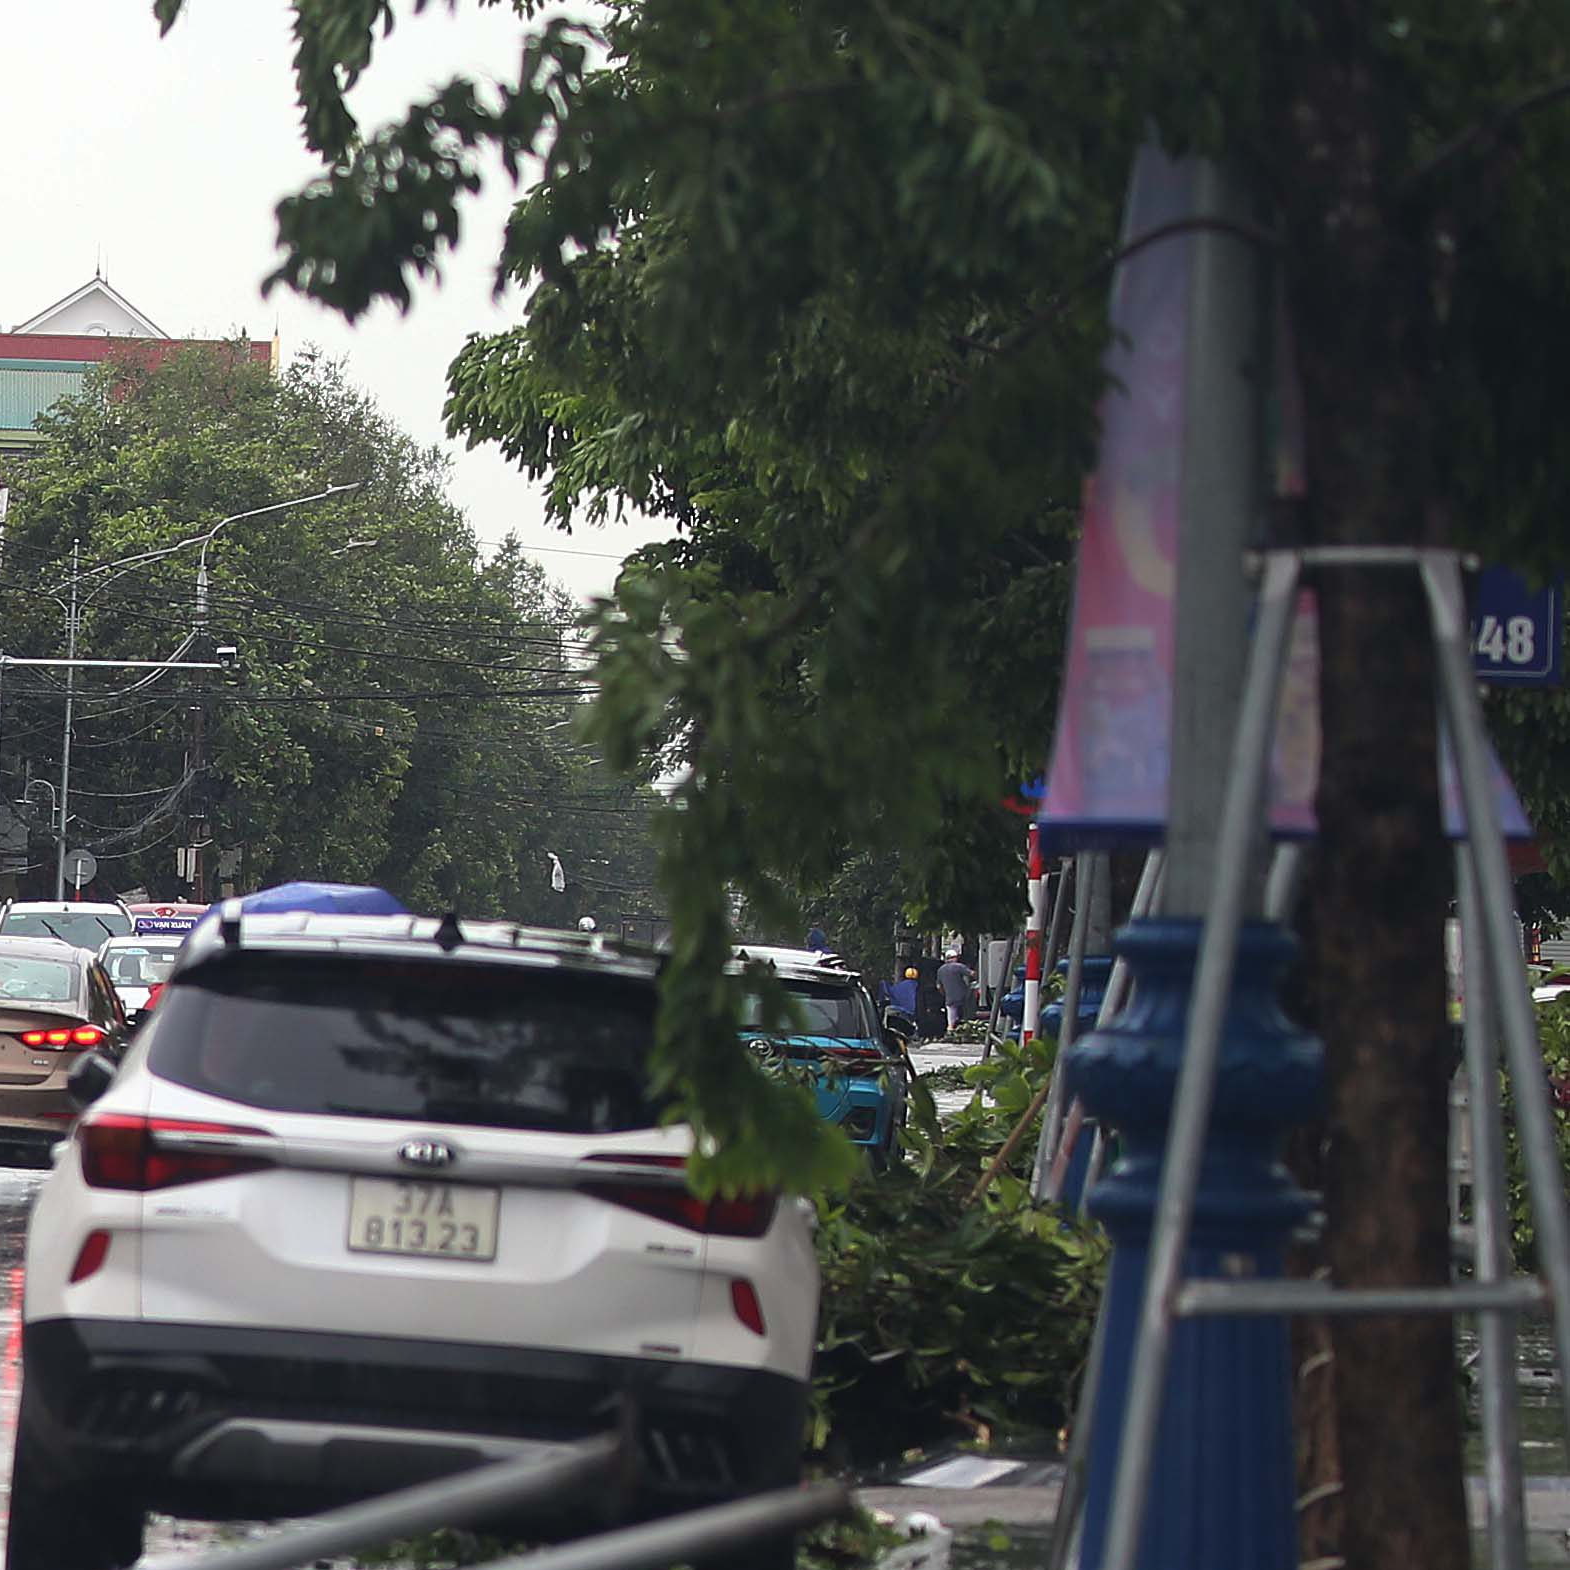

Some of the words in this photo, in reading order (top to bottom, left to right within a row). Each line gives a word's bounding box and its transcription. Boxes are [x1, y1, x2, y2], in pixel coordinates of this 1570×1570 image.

[1470, 614, 1535, 665] 48
[171, 920, 192, 929] XUÂN
[395, 1180, 454, 1217] 37A
